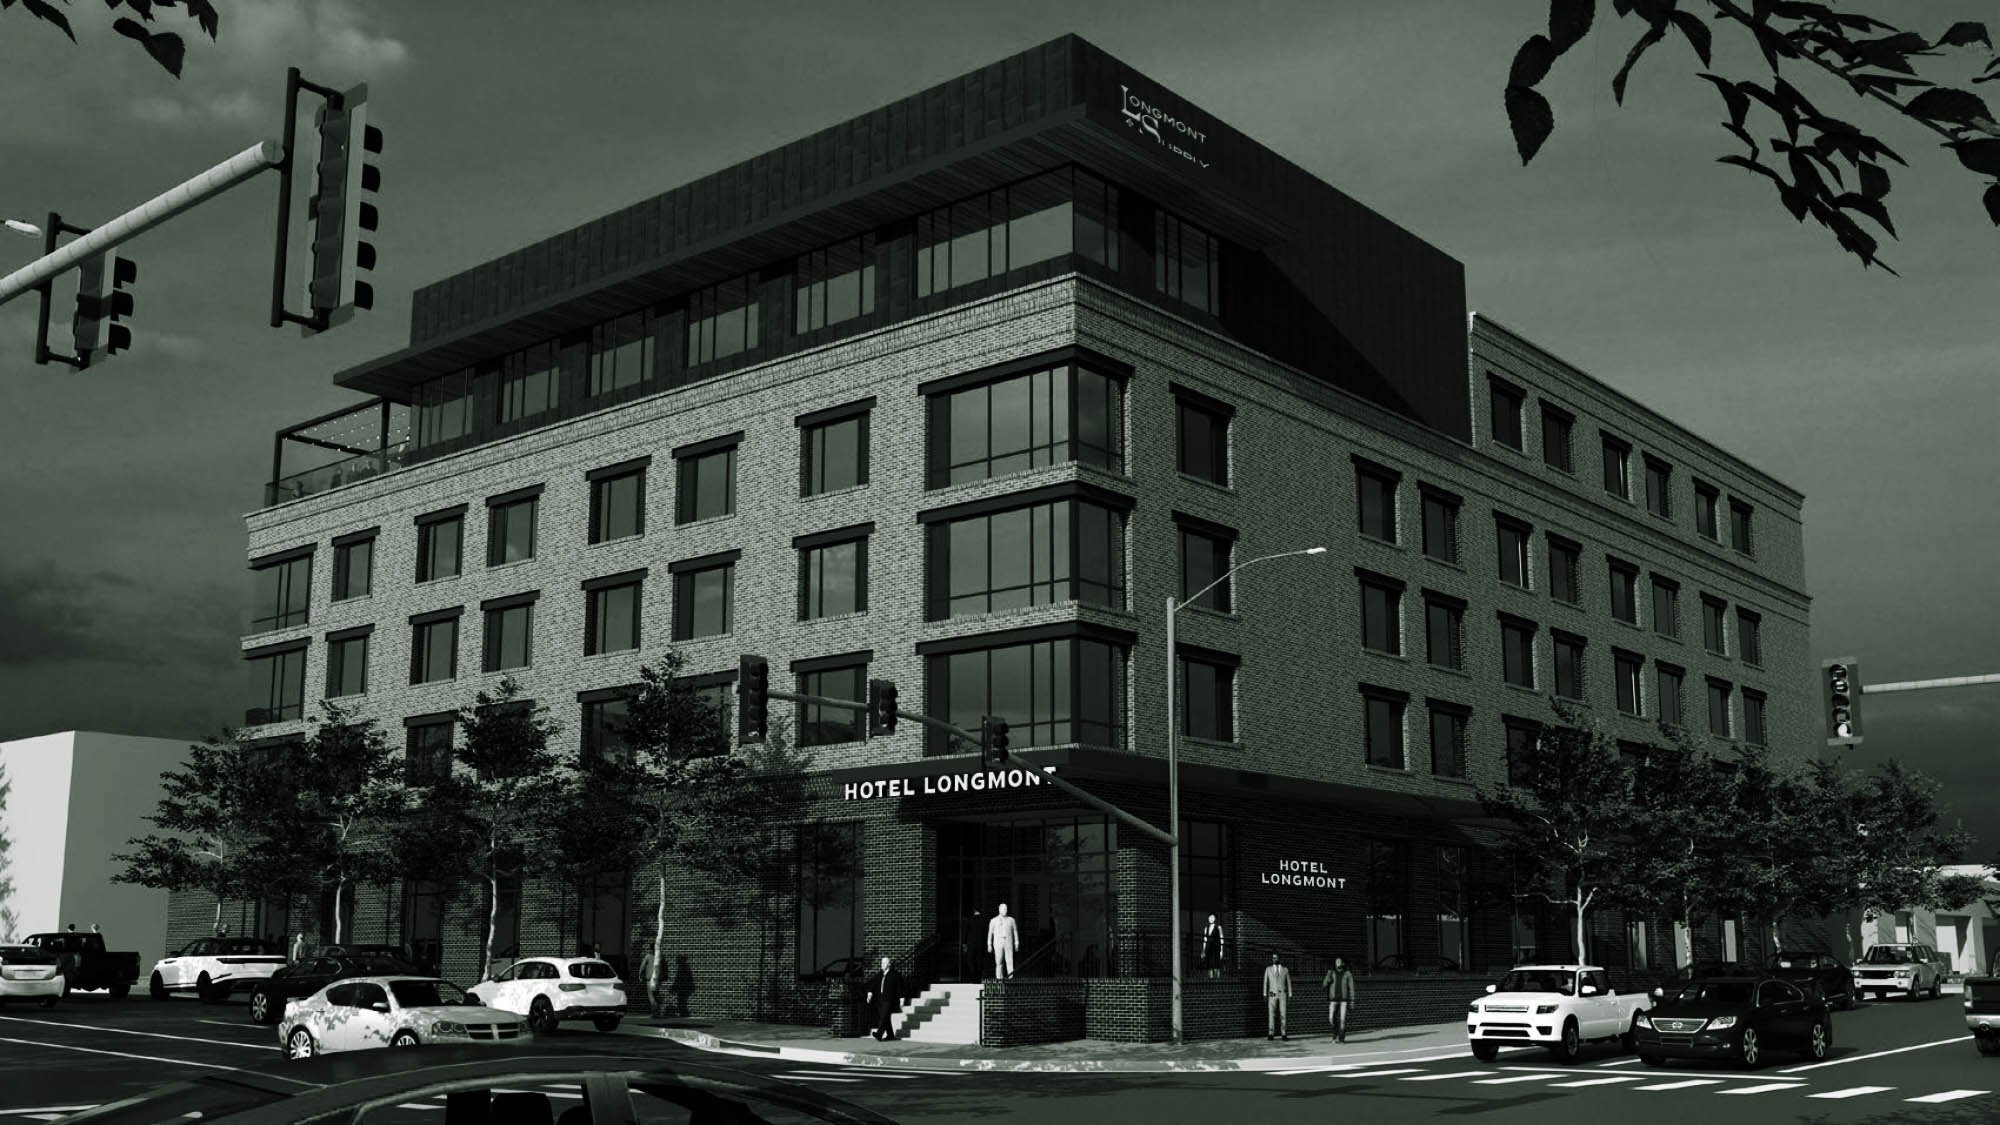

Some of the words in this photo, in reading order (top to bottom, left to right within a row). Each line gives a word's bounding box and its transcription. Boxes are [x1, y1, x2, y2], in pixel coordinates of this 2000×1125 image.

[1120, 84, 1207, 144] LONGMONT
[844, 778, 915, 800] HOTEL
[1279, 859, 1328, 874] HOTEL
[1261, 872, 1346, 889] LONGMONT
